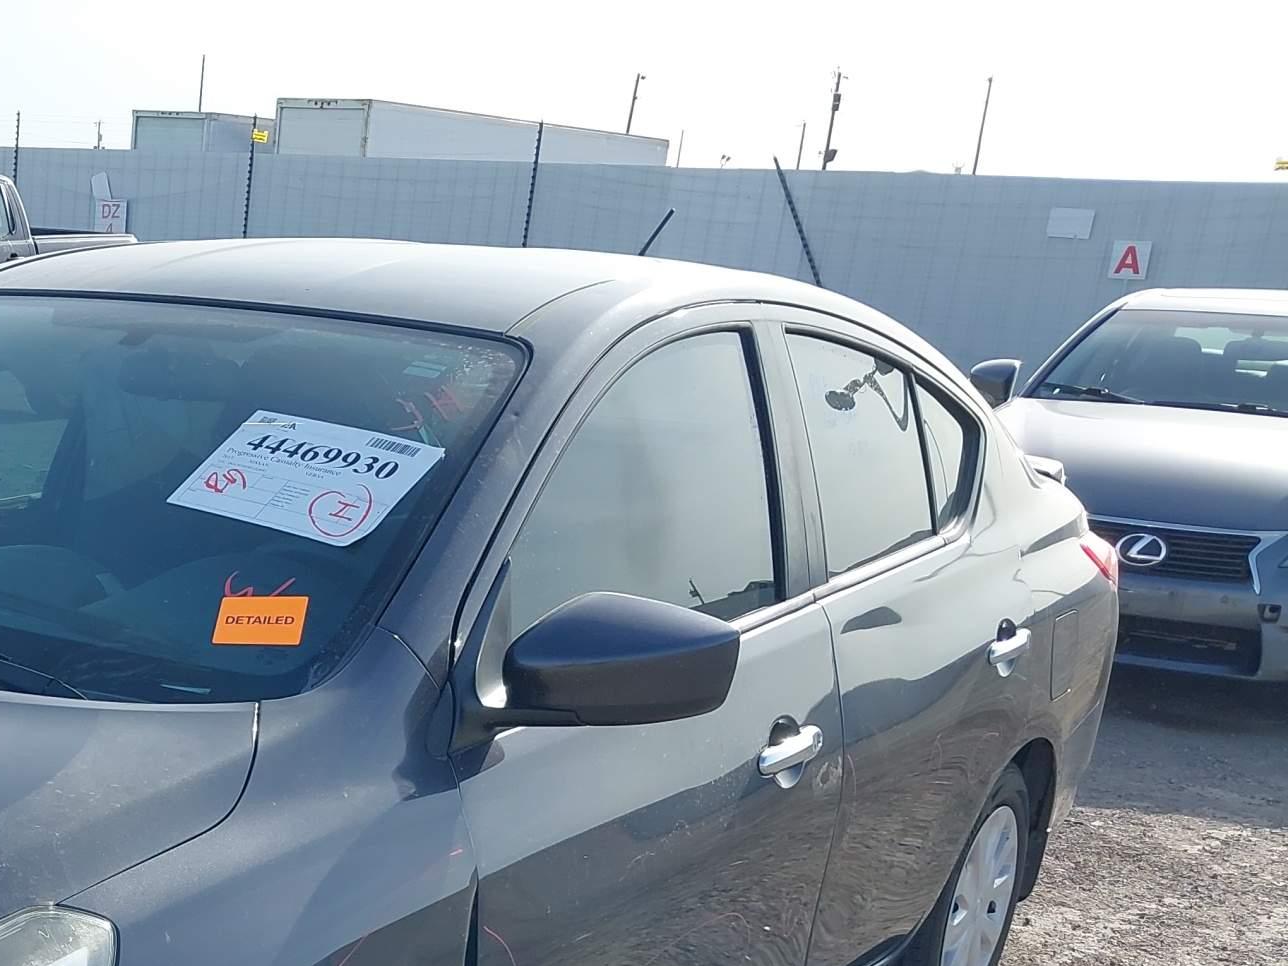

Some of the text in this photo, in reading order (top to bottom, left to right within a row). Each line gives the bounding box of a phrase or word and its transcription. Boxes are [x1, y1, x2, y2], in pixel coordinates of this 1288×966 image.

[102, 203, 121, 219] DZ
[1113, 245, 1140, 275] A
[226, 447, 270, 461] Progressive
[270, 456, 303, 469] Casualty
[303, 463, 343, 477] Insurance
[246, 434, 399, 480] 44469930
[224, 615, 296, 625] DETAILED
